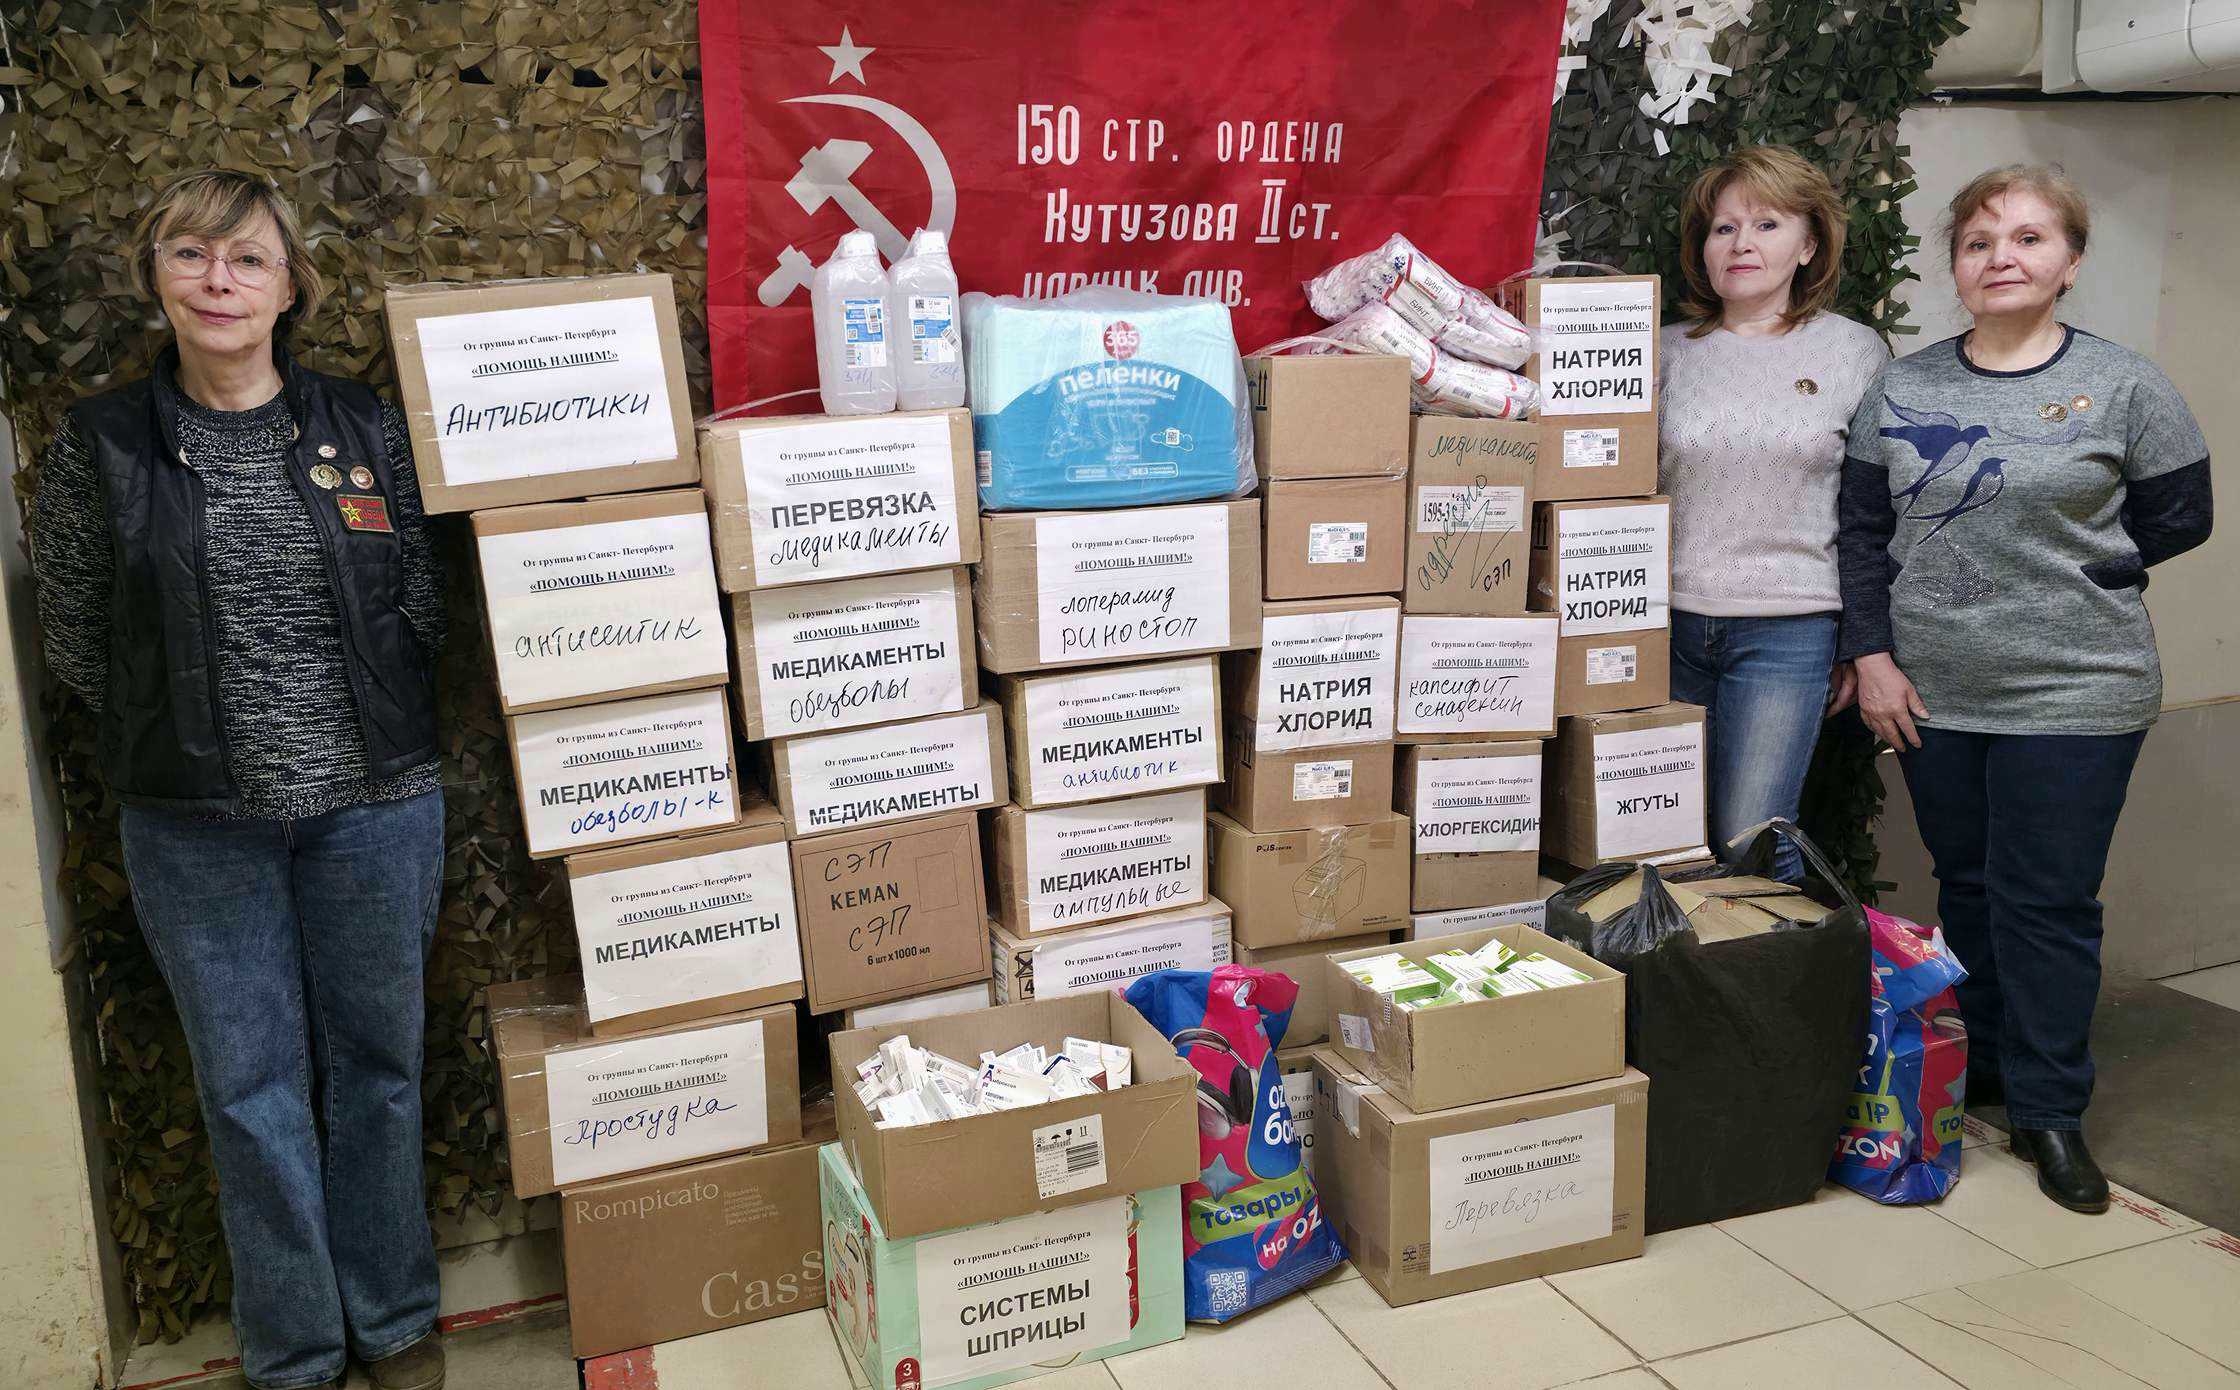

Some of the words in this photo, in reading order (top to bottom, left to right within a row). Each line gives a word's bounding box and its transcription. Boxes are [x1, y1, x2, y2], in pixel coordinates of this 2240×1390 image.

[1017, 104, 1080, 165] 150
[1103, 119, 1179, 161] СТР.
[1217, 120, 1343, 163] ОРДЕНА
[463, 343, 477, 352] От
[479, 340, 515, 351] группы
[530, 336, 563, 344] Санкт-
[564, 329, 617, 341] Петербурга
[1104, 331, 1138, 347] 365
[1555, 324, 1598, 334] ОМОЩЬ
[1601, 322, 1650, 333] НАШИМ!»
[471, 358, 547, 378] «ПОМОЩЬ
[552, 350, 619, 369] НАШИМ!»
[1553, 348, 1642, 369] НАТРИЯ
[1552, 378, 1643, 399] ХЛОРИД
[785, 469, 853, 486] «ПОМОЩЬ
[855, 462, 916, 479] НАШИМ!»
[771, 491, 936, 529] ПЕРЕВЯЗКА
[523, 559, 535, 567] От
[537, 556, 574, 567] группы
[588, 551, 621, 560] Санкт-
[622, 544, 674, 556] Петербурга
[1084, 541, 1113, 550] группы
[1152, 535, 1195, 545] Петербурга
[1561, 547, 1607, 559] «ПОМОЩЬ
[1610, 544, 1653, 555] НАШИМ!»
[1074, 557, 1135, 572] «ПОМОЩЬ
[1138, 553, 1193, 567] НАШИМ!»
[529, 573, 604, 593] «ПОМОЩЬ
[607, 564, 675, 583] НАШИМ!»
[1567, 568, 1646, 592] НАТРИЯ
[1566, 597, 1647, 621] ХЛОРИД
[793, 625, 858, 643] «ПОМОЩЬ
[861, 617, 920, 634] НАШИМ!»
[772, 642, 945, 680] МЕДИКАМЕНТЫ
[1272, 654, 1328, 668] «ПОМОЩЬ
[1331, 650, 1380, 663] НАШИМ!»
[1432, 659, 1483, 668] «ПОМОЩЬ
[1486, 658, 1530, 668] НАШИМ!»
[1280, 677, 1372, 703] НАТРИЯ
[1062, 712, 1123, 729] «ПОМОЩЬ
[1126, 704, 1180, 720] НАШИМ!»
[1277, 707, 1373, 733] ХЛОРИД
[556, 736, 570, 744] От
[571, 732, 606, 743] группы
[619, 727, 651, 736] Санкт-
[652, 720, 703, 732] Петербурга
[1042, 727, 1202, 763] МЕДИКАМЕНТЫ
[562, 748, 634, 768] «ПОМОЩЬ
[637, 738, 702, 758] НАШИМ!»
[1605, 753, 1629, 761] группы
[1662, 744, 1697, 753] Петербурга
[829, 770, 893, 789] «ПОМОЩЬ
[897, 760, 954, 779] НАШИМ!»
[1596, 767, 1648, 782] «ПОМОЩЬ
[1650, 760, 1695, 774] НАШИМ!»
[540, 764, 731, 807] МЕДИКАМЕНТЫ
[809, 783, 979, 825] МЕДИКАМЕНТЫ
[1432, 798, 1483, 809] «ПОМОЩЬ
[1486, 794, 1531, 805] НАШИМ!»
[1617, 793, 1679, 815] ЖГУТЫ
[1419, 817, 1541, 838] ХЛОРГЕКСИДИН
[1060, 842, 1118, 860] «ПОМОЩЬ
[1120, 833, 1172, 850] НАШИМ!»
[1040, 855, 1191, 894] МЕДИКАМЕНТЫ
[617, 903, 686, 926] «ПОМОЩЬ
[690, 891, 752, 912] НАШИМ!»
[831, 882, 899, 911] KEMAN
[595, 913, 781, 964] МЕДИКАМЕНТЫ
[867, 955, 873, 965] 6
[1077, 955, 1104, 966] группы
[1115, 949, 1141, 958] Санкт-
[1142, 942, 1182, 953] Петербурга
[1068, 968, 1126, 988] «ПОМОЩЬ
[1129, 959, 1181, 977] НАШИМ!»
[587, 1074, 601, 1082] От
[602, 1068, 635, 1080] группы
[648, 1061, 679, 1071] Санкт-
[681, 1052, 728, 1066] Петербурга
[591, 1083, 662, 1105] «ПОМОЩЬ
[664, 1071, 727, 1092] НАШИМ!»
[1475, 1150, 1502, 1162] группы
[1514, 1144, 1540, 1153] Санкт-
[1541, 1134, 1583, 1147] Петербурга
[1464, 1163, 1524, 1185] «ПОМОЩЬ
[1527, 1153, 1581, 1171] НАШИМ!»
[574, 1181, 719, 1224] Rompicato
[1200, 1185, 1303, 1229] товары
[953, 1259, 966, 1267] От
[967, 1251, 1000, 1264] группы
[1013, 1242, 1043, 1253] Санкт-
[1044, 1231, 1091, 1247] Петербурга
[957, 1265, 1025, 1290] «ПОМОЩЬ
[1029, 1250, 1090, 1274] НАШИМ!»
[960, 1279, 1090, 1326] СИСТЕМЫ
[967, 1312, 1086, 1358] ШПРИЦЫ
[903, 1363, 912, 1376] 3
